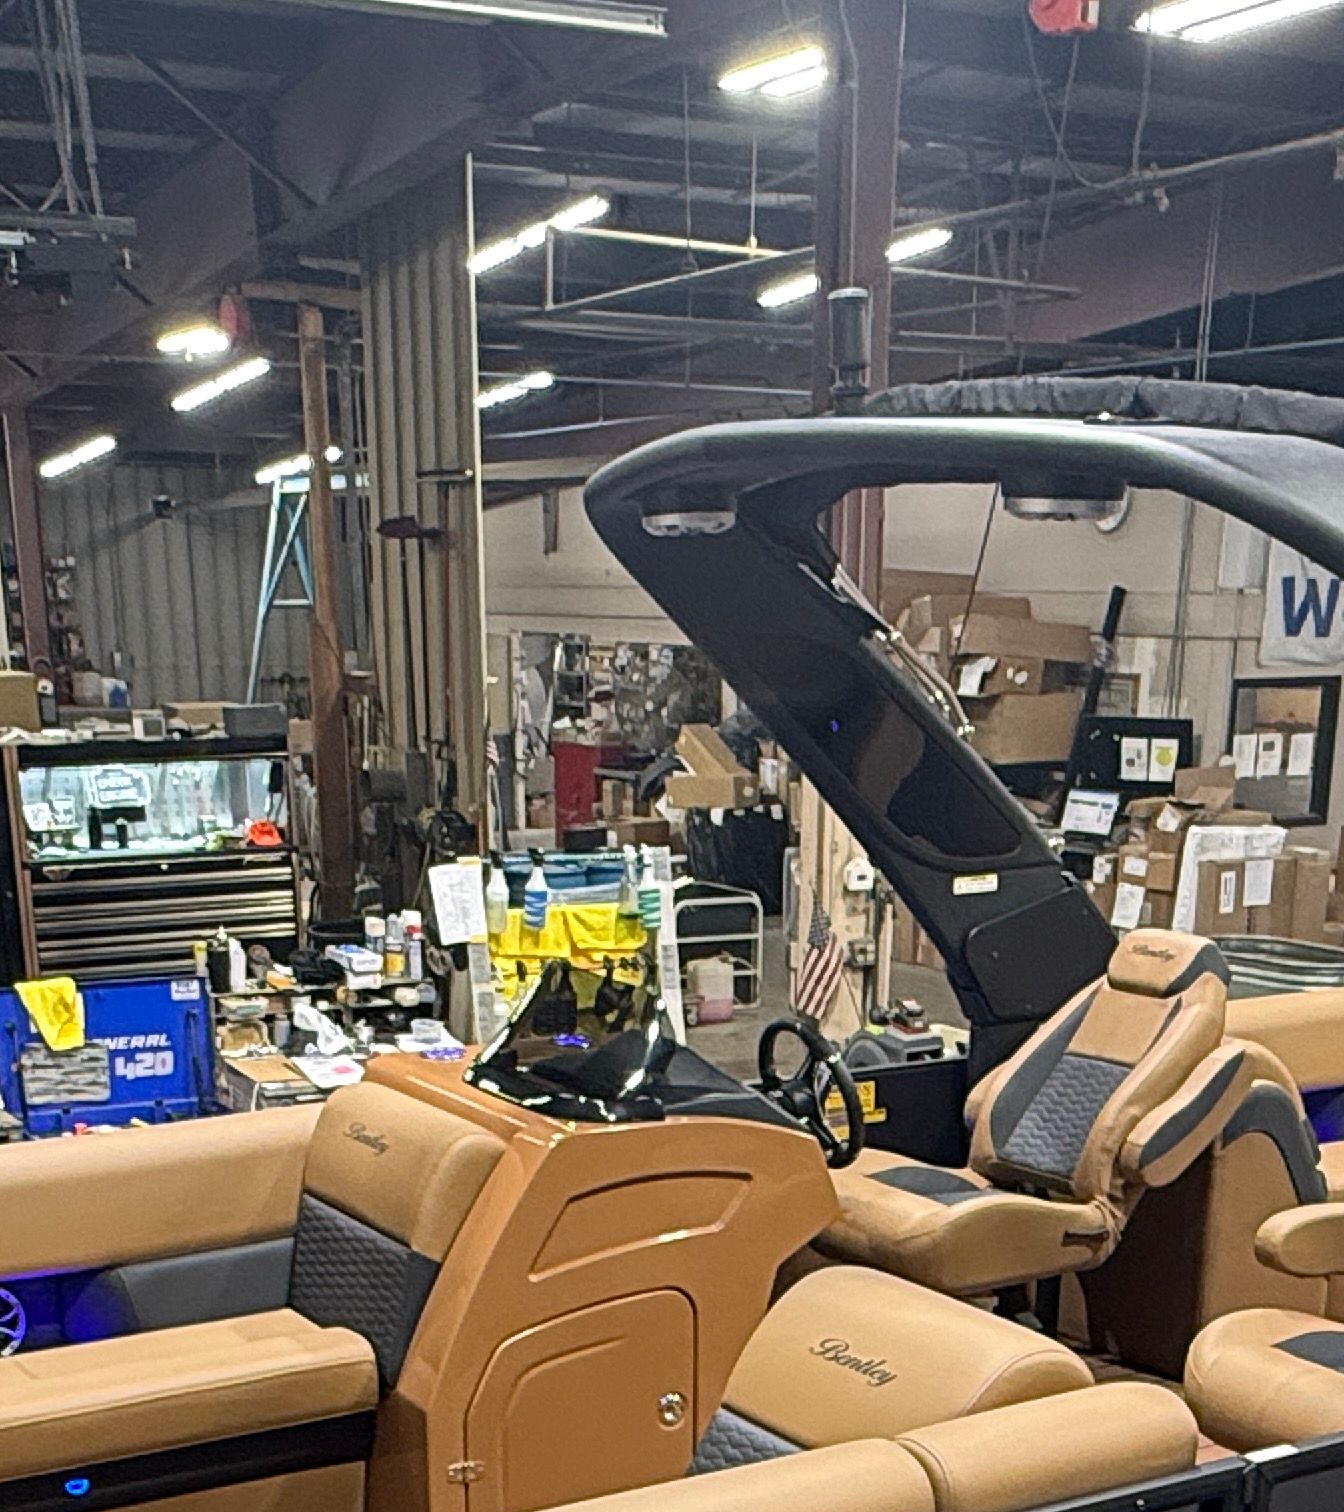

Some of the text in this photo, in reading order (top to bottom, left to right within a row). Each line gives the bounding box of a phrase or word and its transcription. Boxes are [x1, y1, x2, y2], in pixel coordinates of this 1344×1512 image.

[90, 1033, 172, 1050] NERAL
[114, 1051, 174, 1080] 420
[808, 1338, 898, 1387] Bentley
